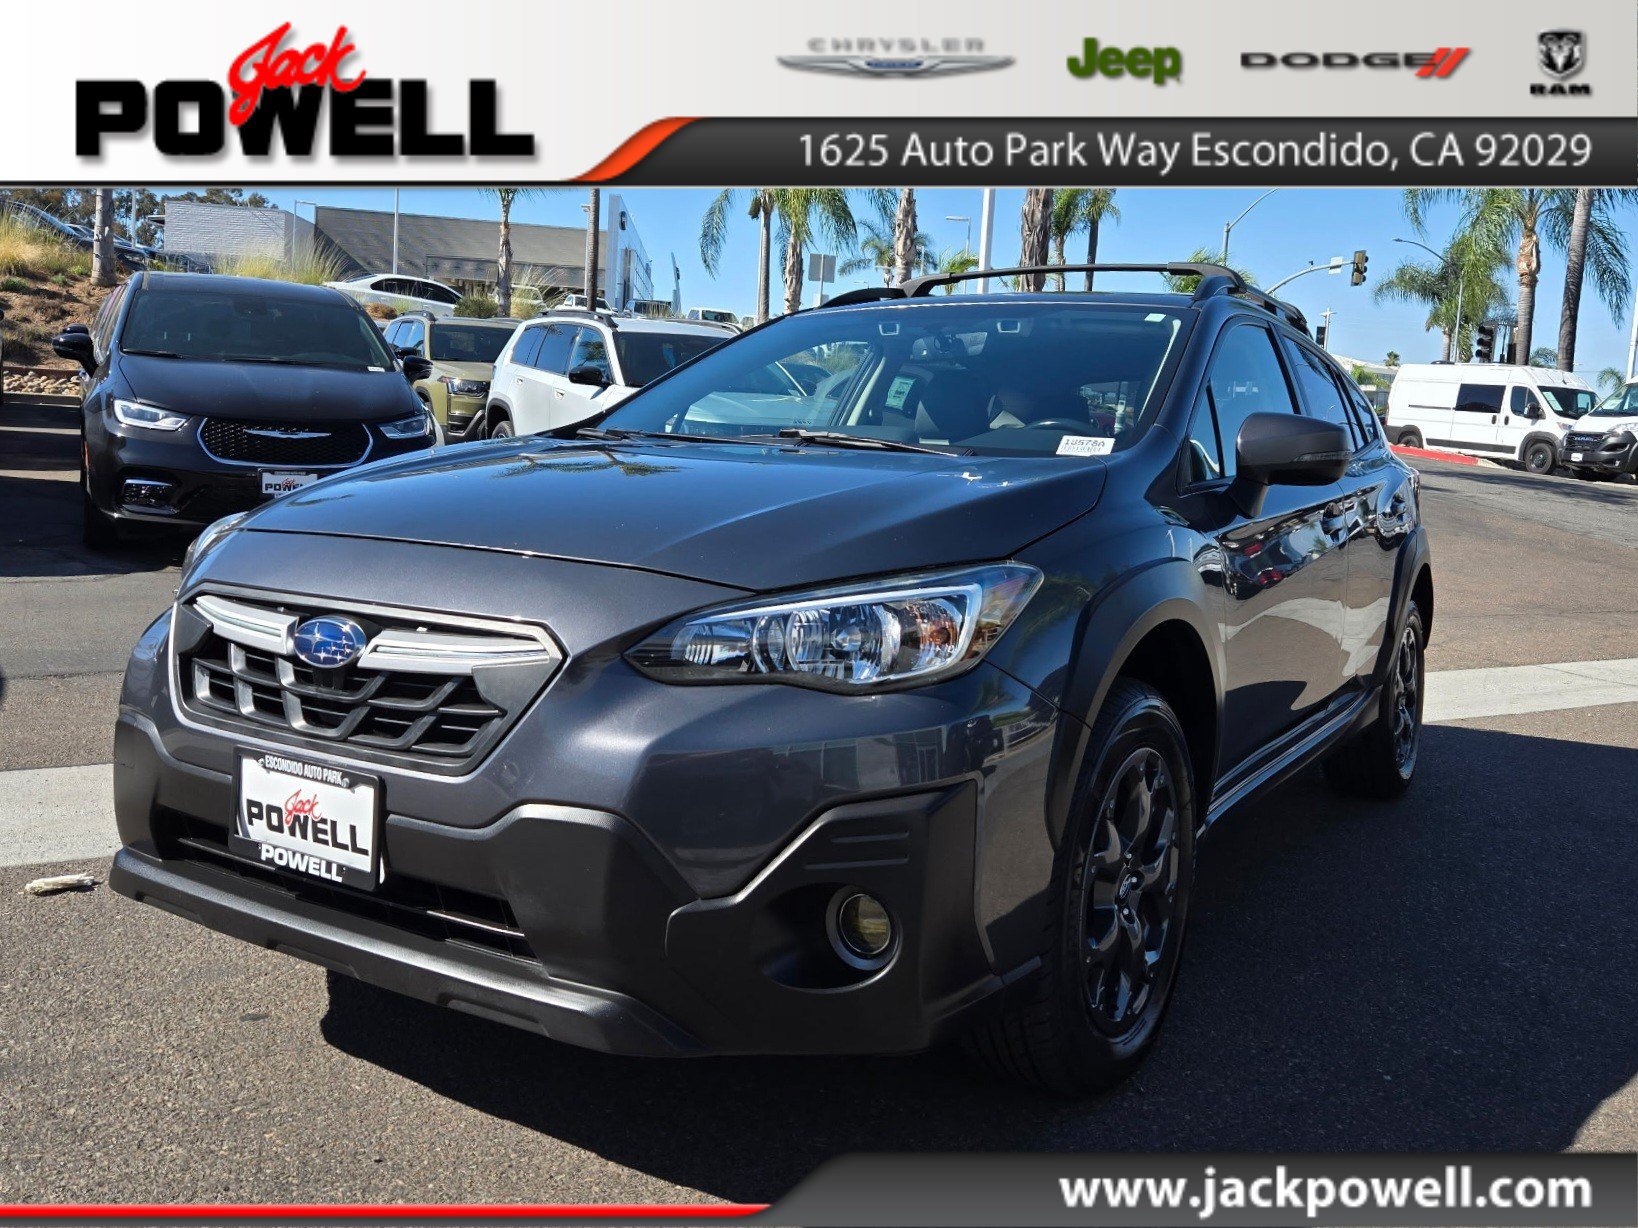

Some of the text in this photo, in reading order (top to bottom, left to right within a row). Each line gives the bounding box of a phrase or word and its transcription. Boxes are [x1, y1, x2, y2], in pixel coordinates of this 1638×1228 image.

[264, 754, 343, 786] ESCONDIDO AUTO PARK
[246, 798, 370, 857] POWELL
[284, 788, 322, 827] Jack
[260, 842, 343, 883] POWELL
